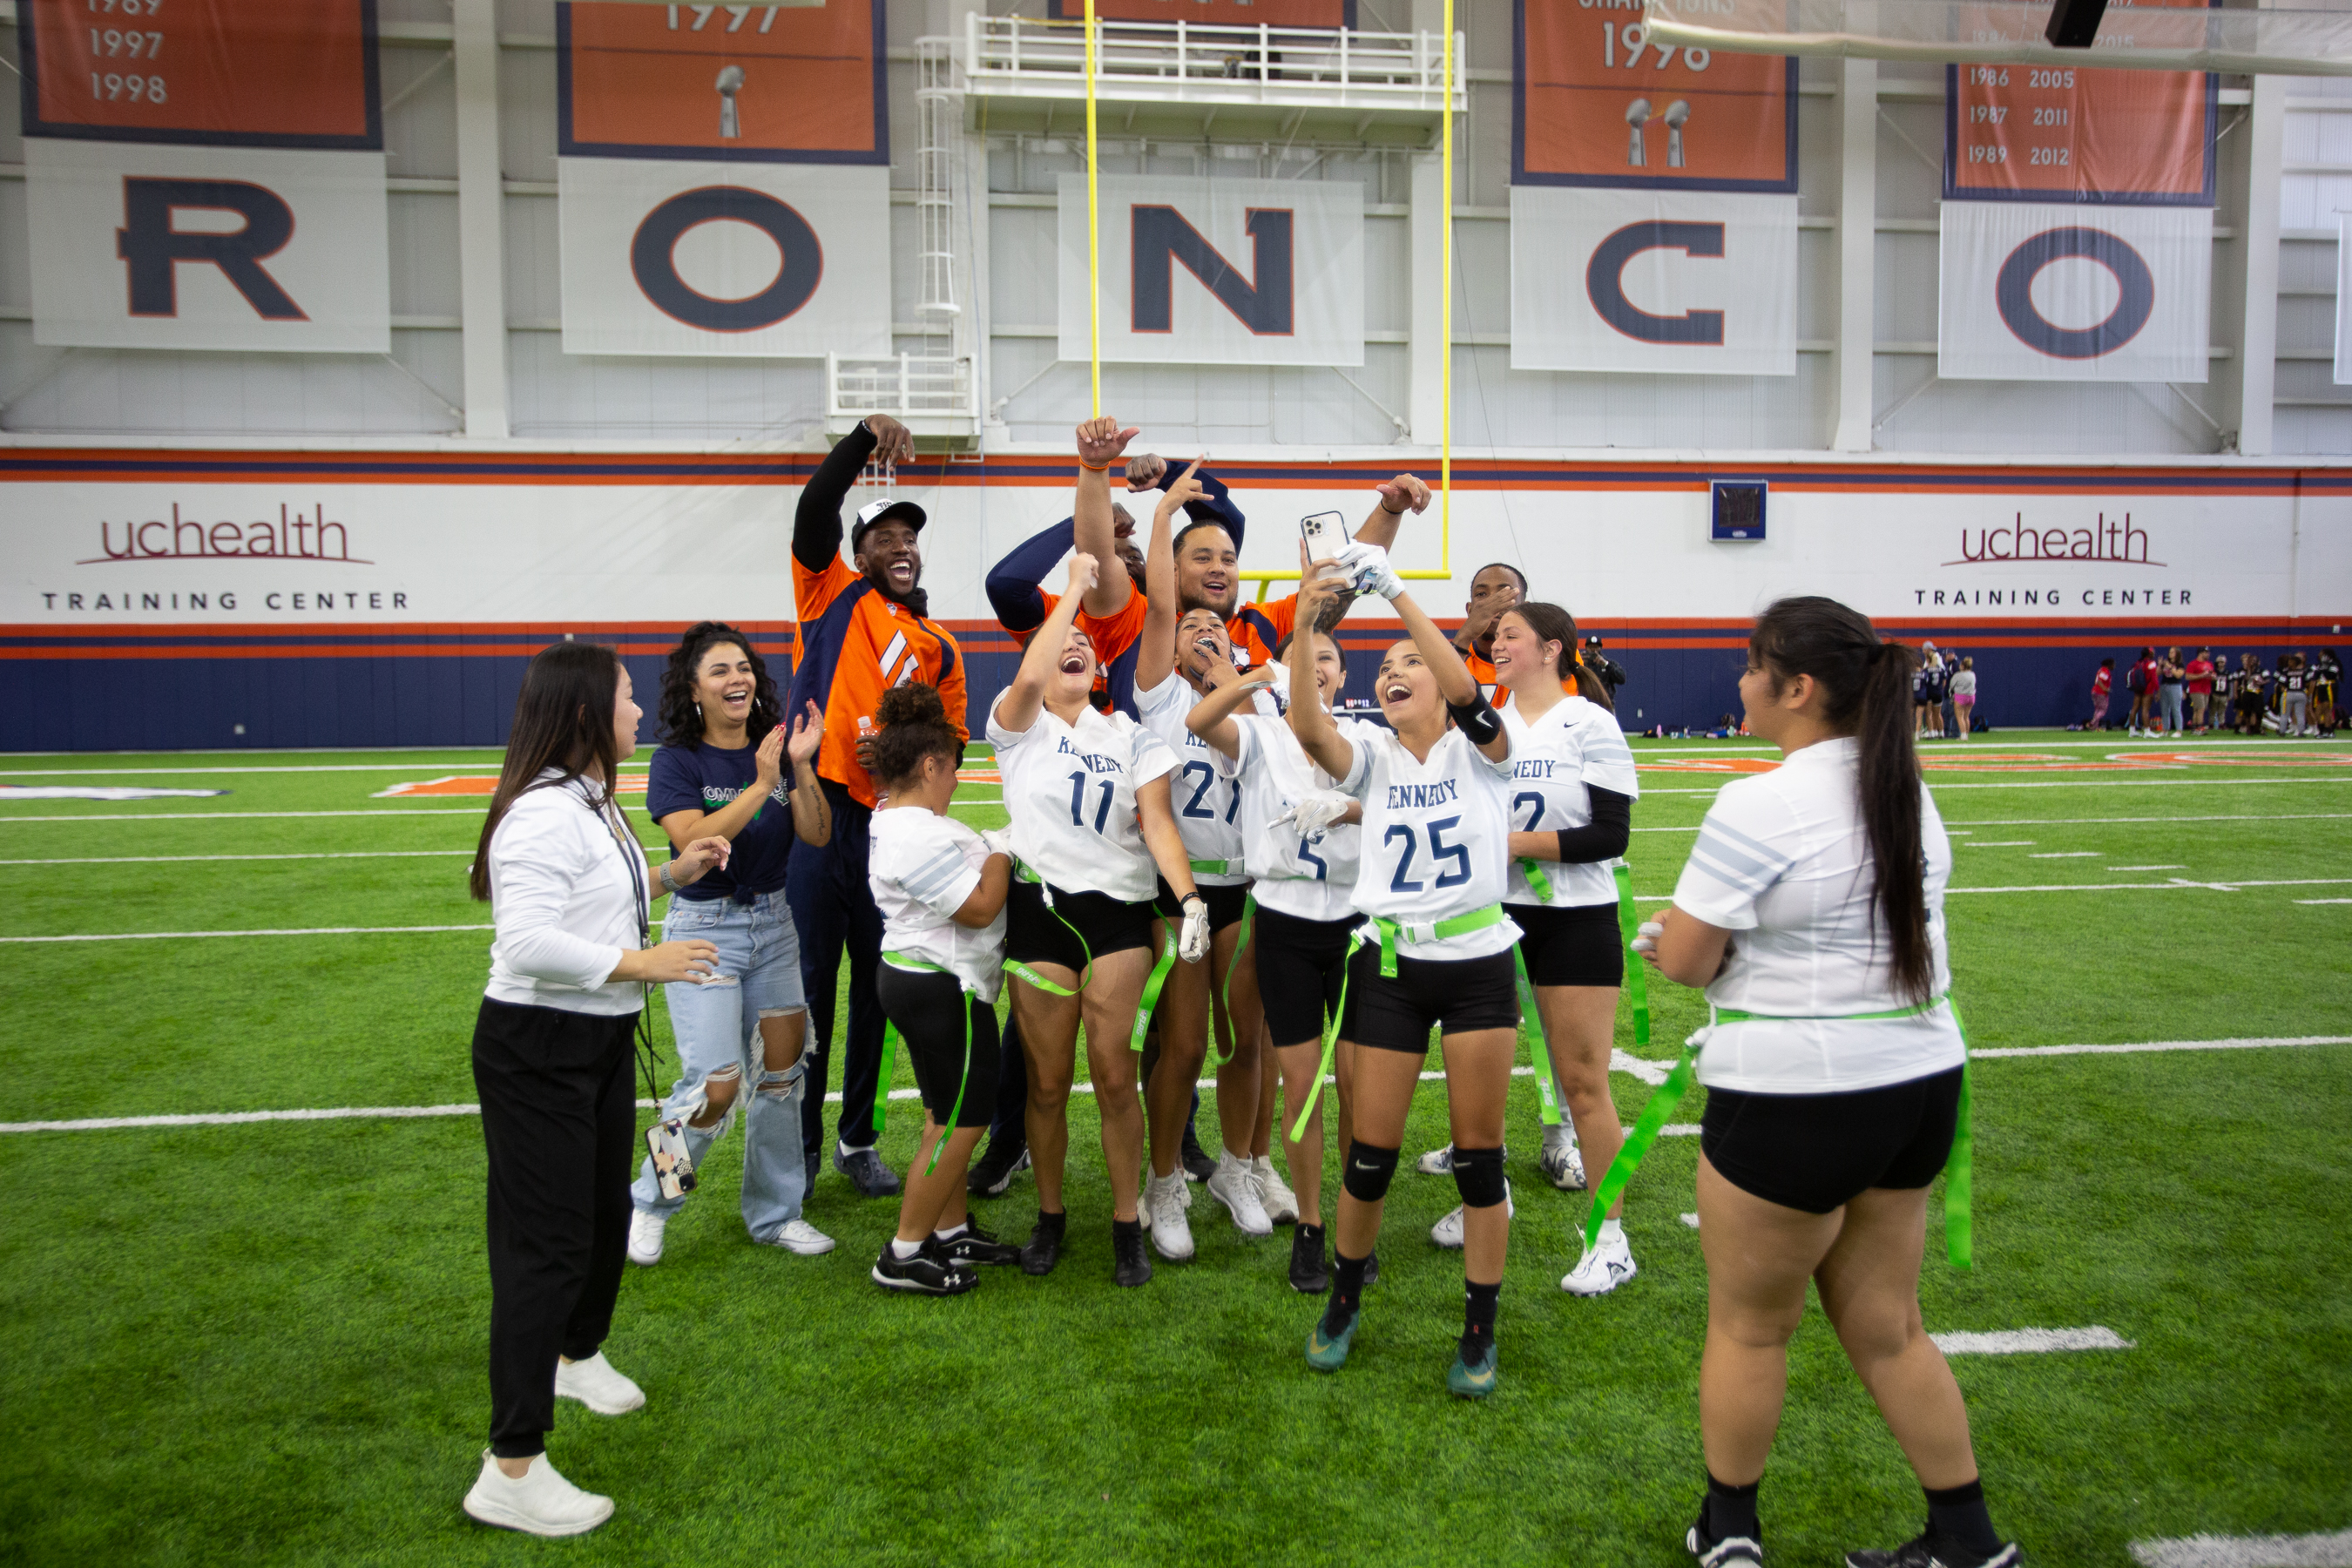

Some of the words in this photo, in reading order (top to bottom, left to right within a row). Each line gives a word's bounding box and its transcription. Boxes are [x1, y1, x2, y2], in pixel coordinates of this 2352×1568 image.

[90, 28, 164, 60] 1997
[91, 71, 168, 105] 1998
[1970, 67, 2010, 87] 1986
[2029, 69, 2075, 90] 2005
[1969, 105, 2009, 125] 1987
[2032, 106, 2069, 126] 2011
[1968, 145, 2008, 164] 1989
[2030, 146, 2070, 166] 2012
[115, 175, 311, 321] R
[630, 185, 823, 333] O
[1131, 203, 1294, 336] N
[1585, 220, 1725, 346] C
[1996, 226, 2154, 360] O
[101, 502, 349, 562] uchealth
[1962, 511, 2149, 564] uchealth
[41, 592, 238, 611] TRAINING
[265, 592, 409, 610] CENTER
[1915, 590, 2061, 605] TRAINING
[2082, 590, 2193, 605] CENTER
[1067, 770, 1115, 836] 11
[1383, 814, 1472, 894] 25
[1016, 966, 1036, 983] FLAG
[1135, 1015, 1147, 1037] FLAG
[1539, 1082, 1554, 1106] FLAG
